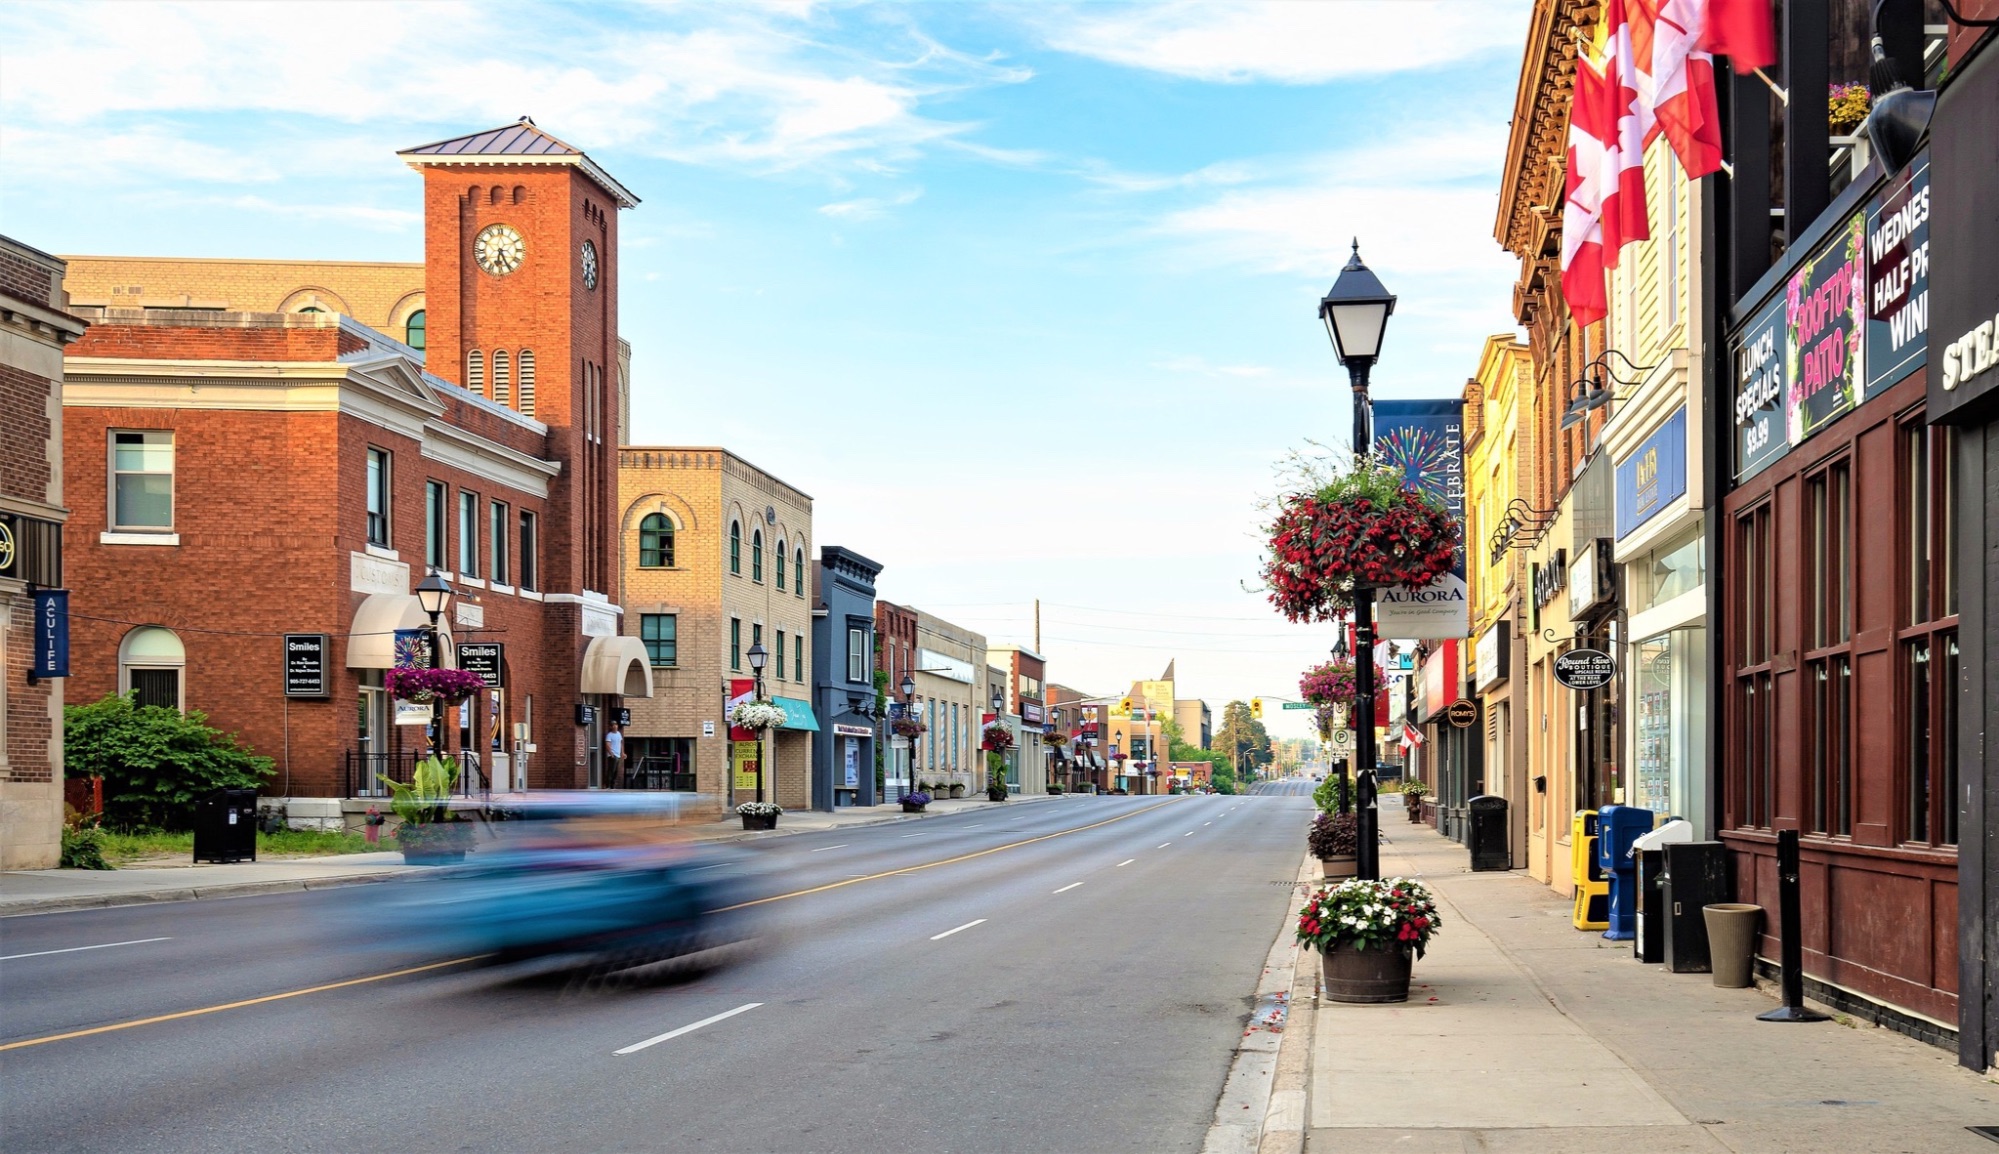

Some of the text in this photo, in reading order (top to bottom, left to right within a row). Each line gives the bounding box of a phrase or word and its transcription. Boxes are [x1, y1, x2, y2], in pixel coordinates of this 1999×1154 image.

[1797, 260, 1853, 347] ROOFTOP
[1874, 256, 1910, 316] HALF
[1742, 326, 1774, 382] LUNCH
[1804, 326, 1844, 399] PATIO
[1736, 363, 1780, 425] SPECIALS
[1747, 417, 1769, 458] $9.99
[1381, 588, 1465, 603] AURORA
[1432, 608, 1459, 616] Company
[46, 597, 56, 671] ACULIFE
[289, 642, 320, 651] Smiles
[461, 646, 497, 656] Smiles
[1558, 656, 1590, 670] Round
